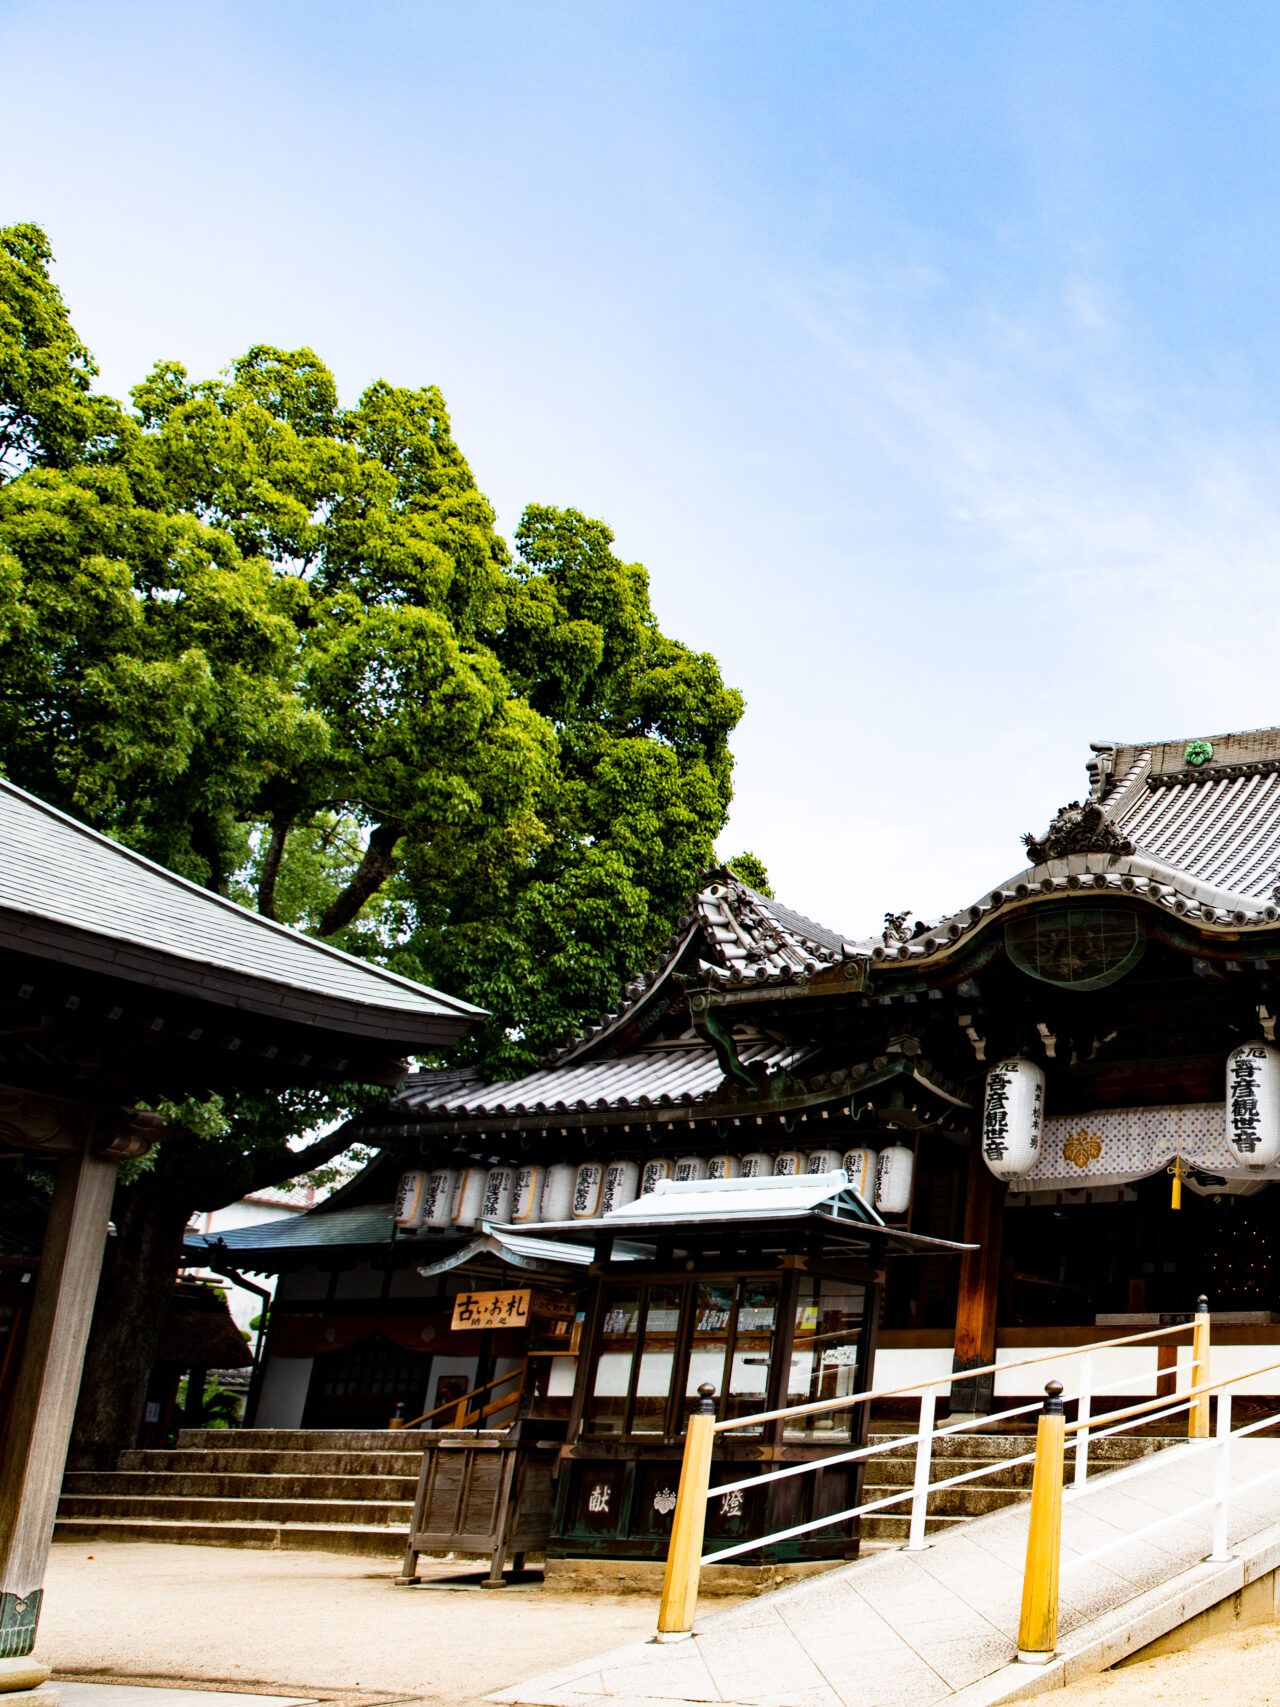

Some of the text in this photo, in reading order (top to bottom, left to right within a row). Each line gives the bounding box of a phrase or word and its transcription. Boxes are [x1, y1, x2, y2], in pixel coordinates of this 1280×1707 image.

[983, 1073, 1012, 1161] 吾彦観世音
[1230, 1059, 1262, 1153] 吾彦観世音
[483, 1172, 504, 1216] 開運厄除
[574, 1167, 592, 1211] 商売繁昌
[457, 1295, 526, 1321] 古いお札
[588, 1485, 612, 1513] 献
